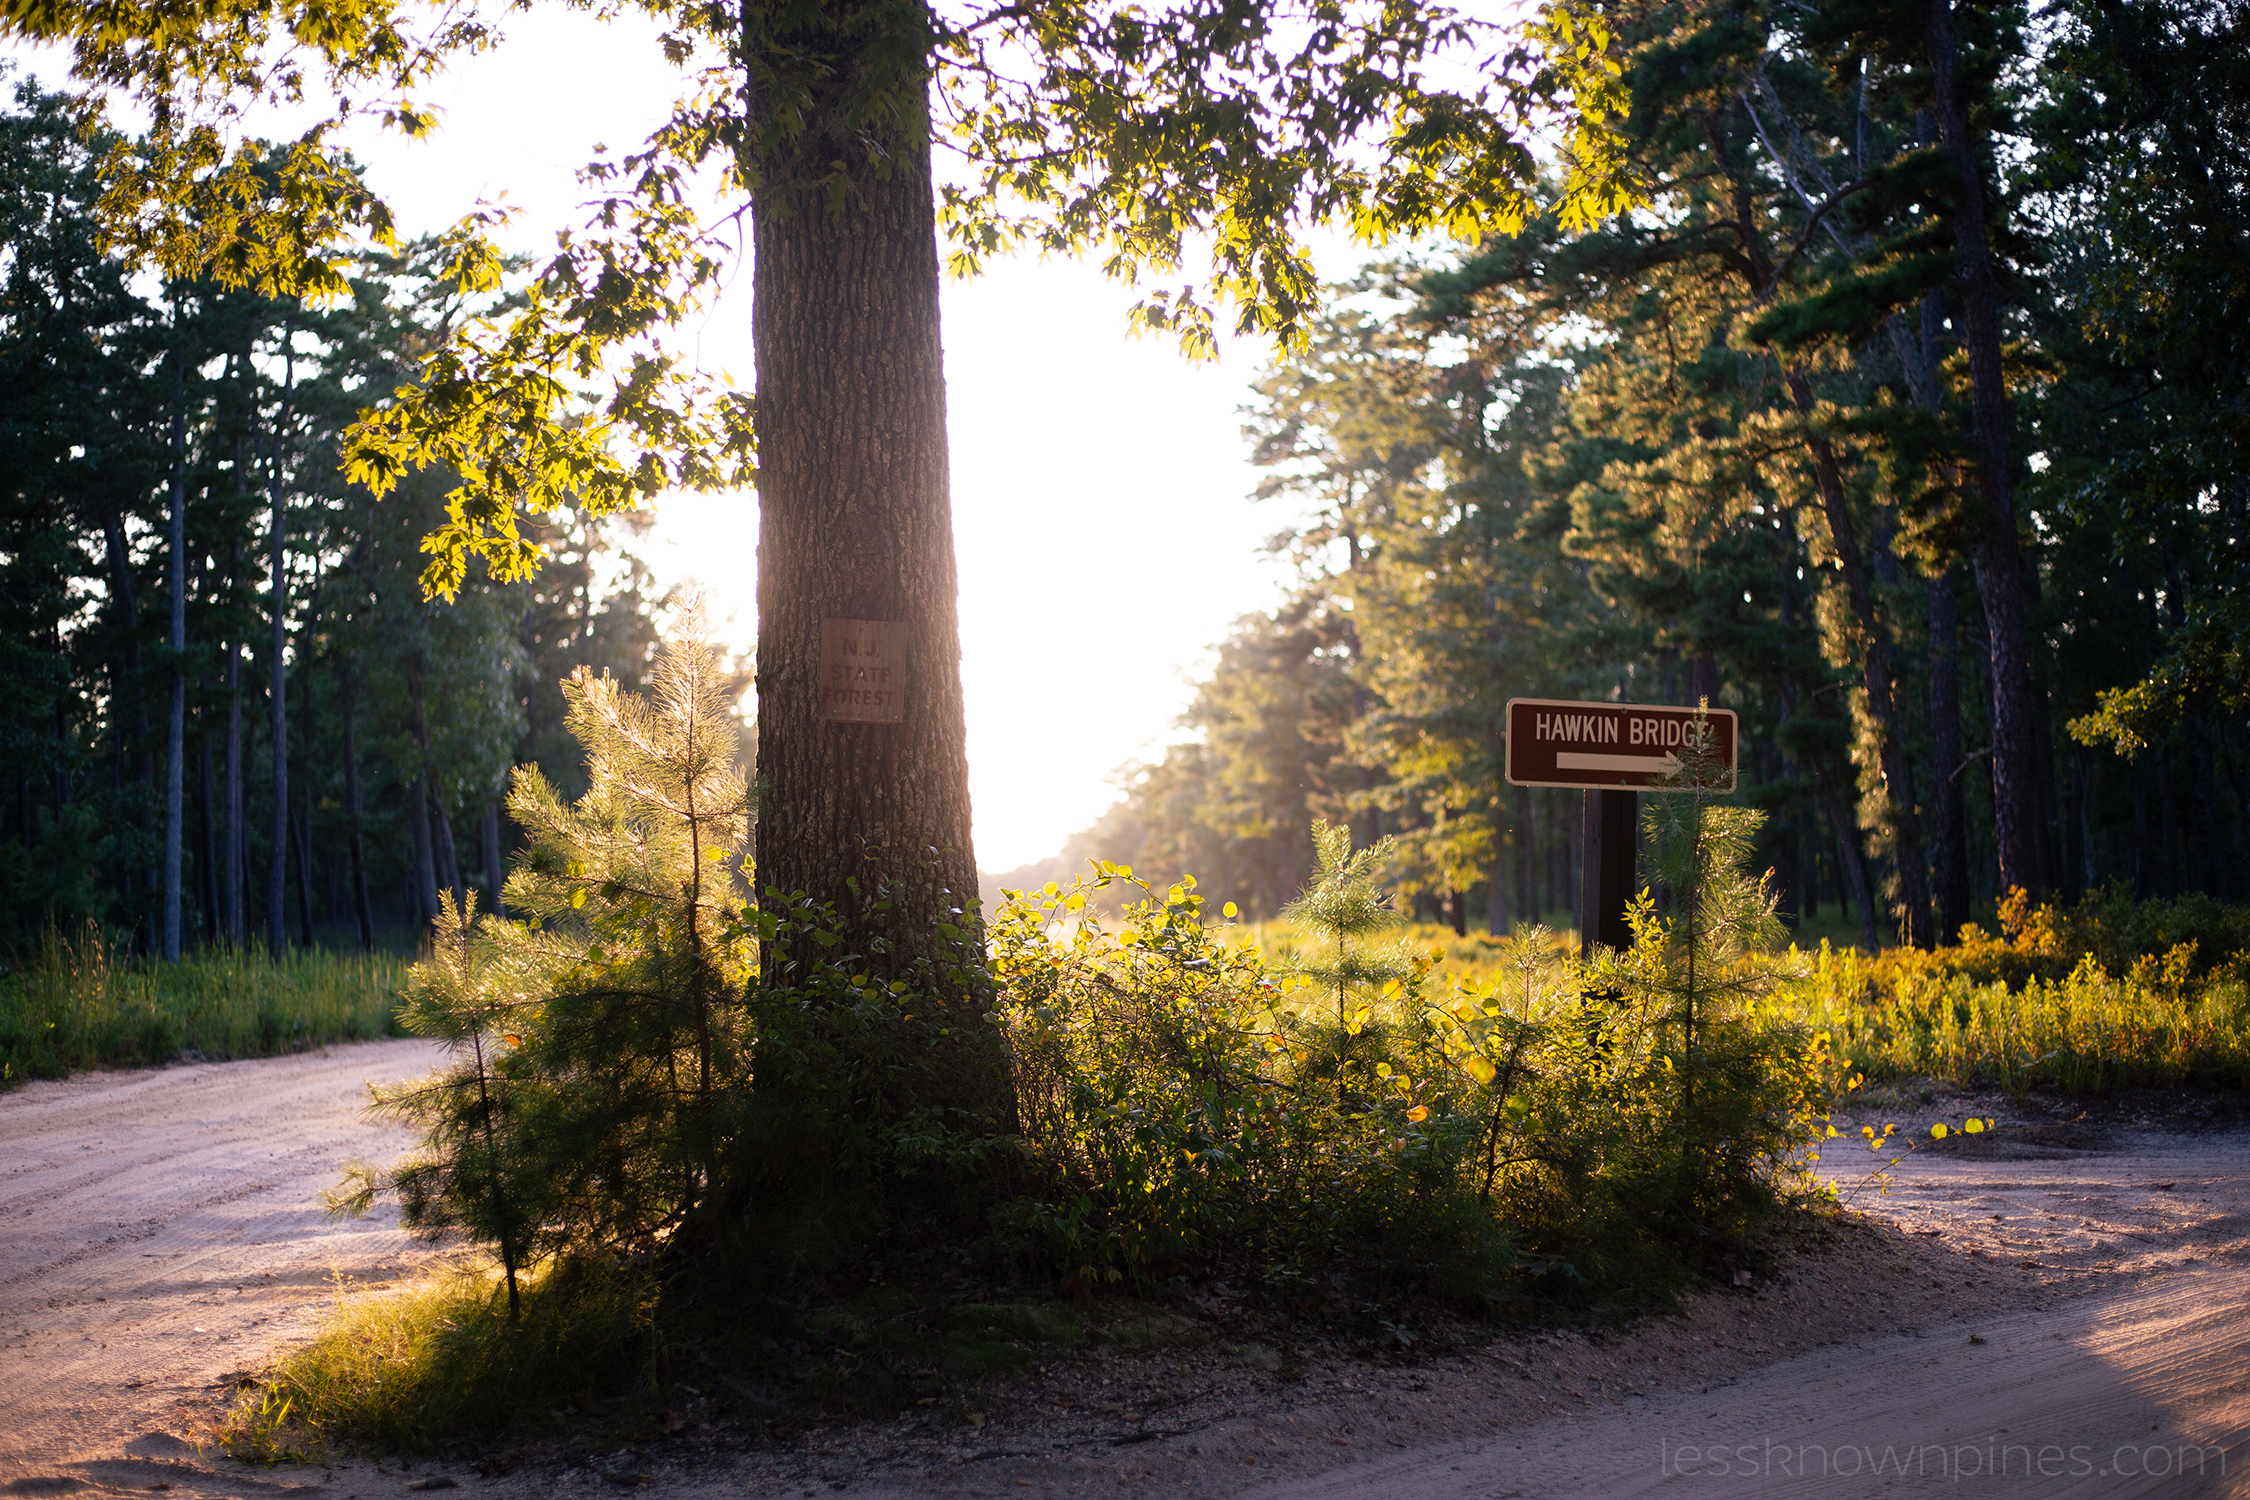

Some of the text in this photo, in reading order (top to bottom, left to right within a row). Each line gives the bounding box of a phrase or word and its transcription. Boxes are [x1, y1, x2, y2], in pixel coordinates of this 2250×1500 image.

[842, 638, 880, 658] N.J.
[831, 663, 891, 683] STATE
[822, 686, 895, 707] FOREST
[1536, 713, 1710, 748] HAWKIN BRIDGE
